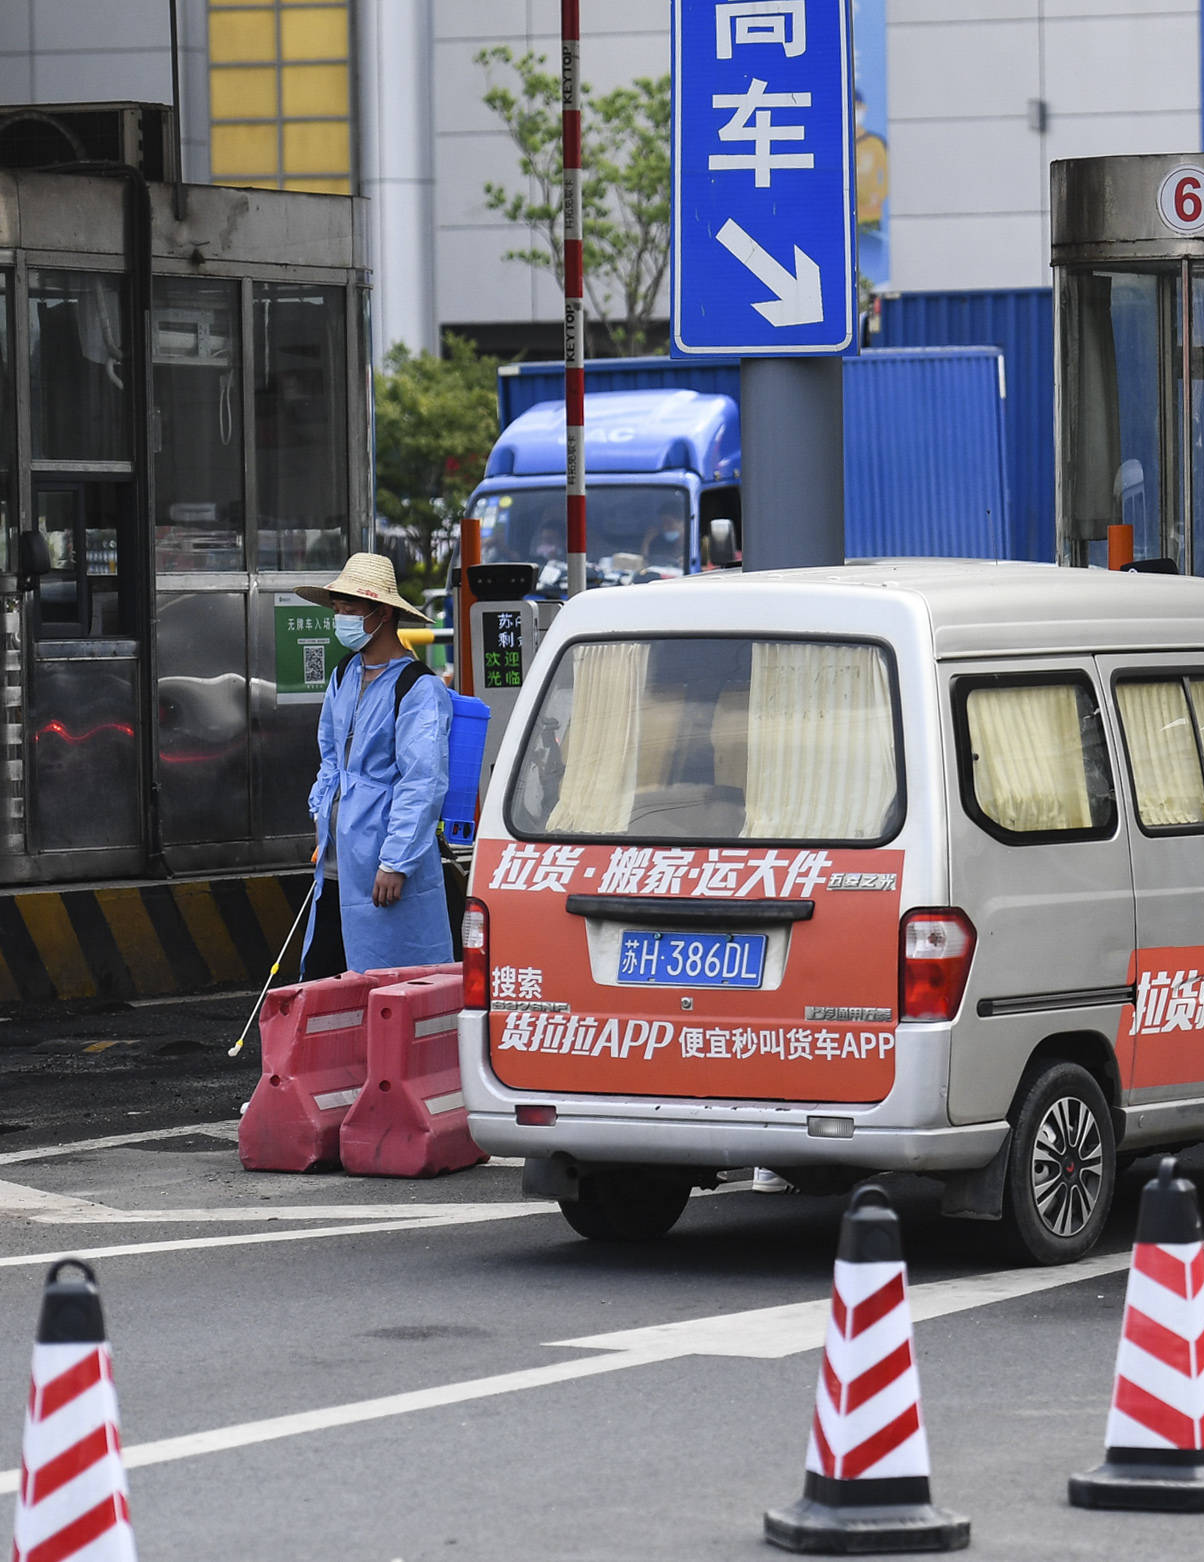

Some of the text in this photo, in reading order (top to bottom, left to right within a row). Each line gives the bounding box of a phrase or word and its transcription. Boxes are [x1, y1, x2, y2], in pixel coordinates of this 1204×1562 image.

[562, 46, 573, 105] KEYTOP
[1174, 176, 1203, 223] 6
[565, 304, 575, 362] KEYTOP
[485, 652, 520, 668] 欢迎
[488, 670, 521, 687] 光临
[491, 966, 543, 999] 搜索
[498, 1012, 896, 1061] 货拉拉APP 便宜秒叫货车APP
